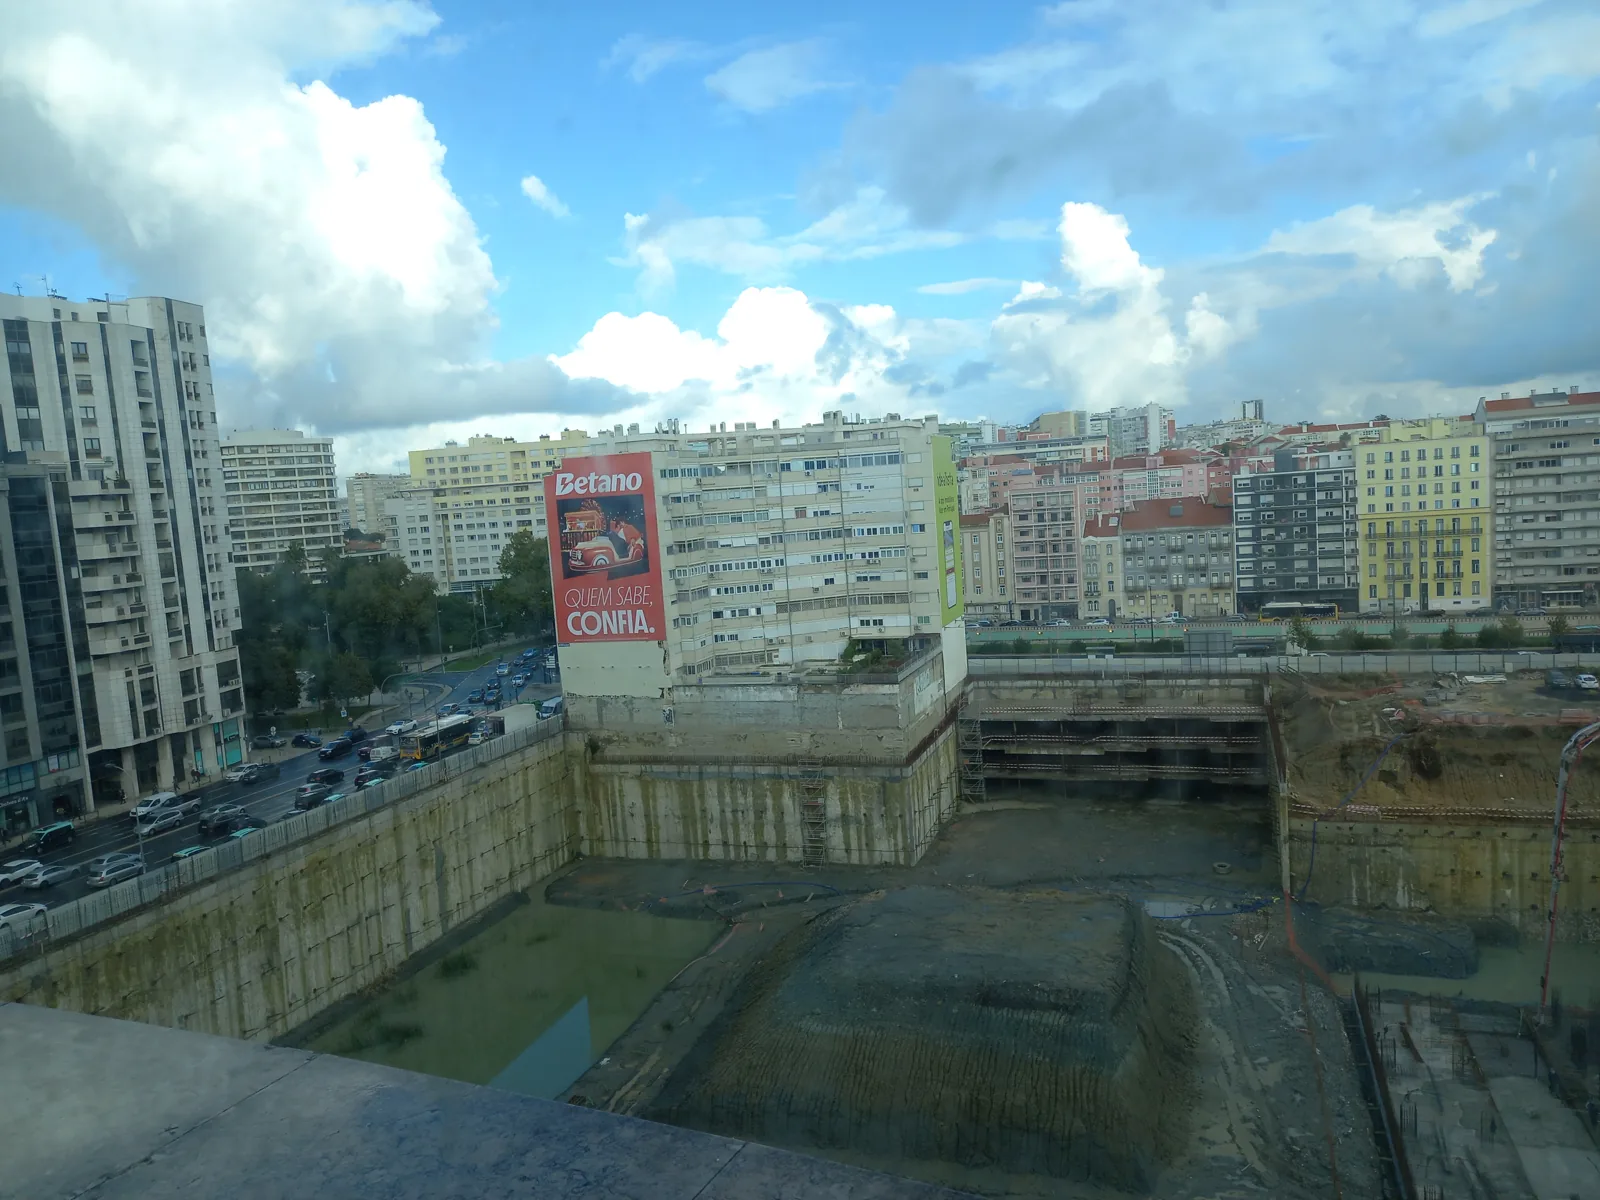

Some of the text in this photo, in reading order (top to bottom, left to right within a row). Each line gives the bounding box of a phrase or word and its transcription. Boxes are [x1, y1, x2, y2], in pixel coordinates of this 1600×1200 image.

[556, 472, 642, 495] Betano
[565, 585, 653, 608] QUEM SABE,
[567, 609, 655, 635] CONFIA.
